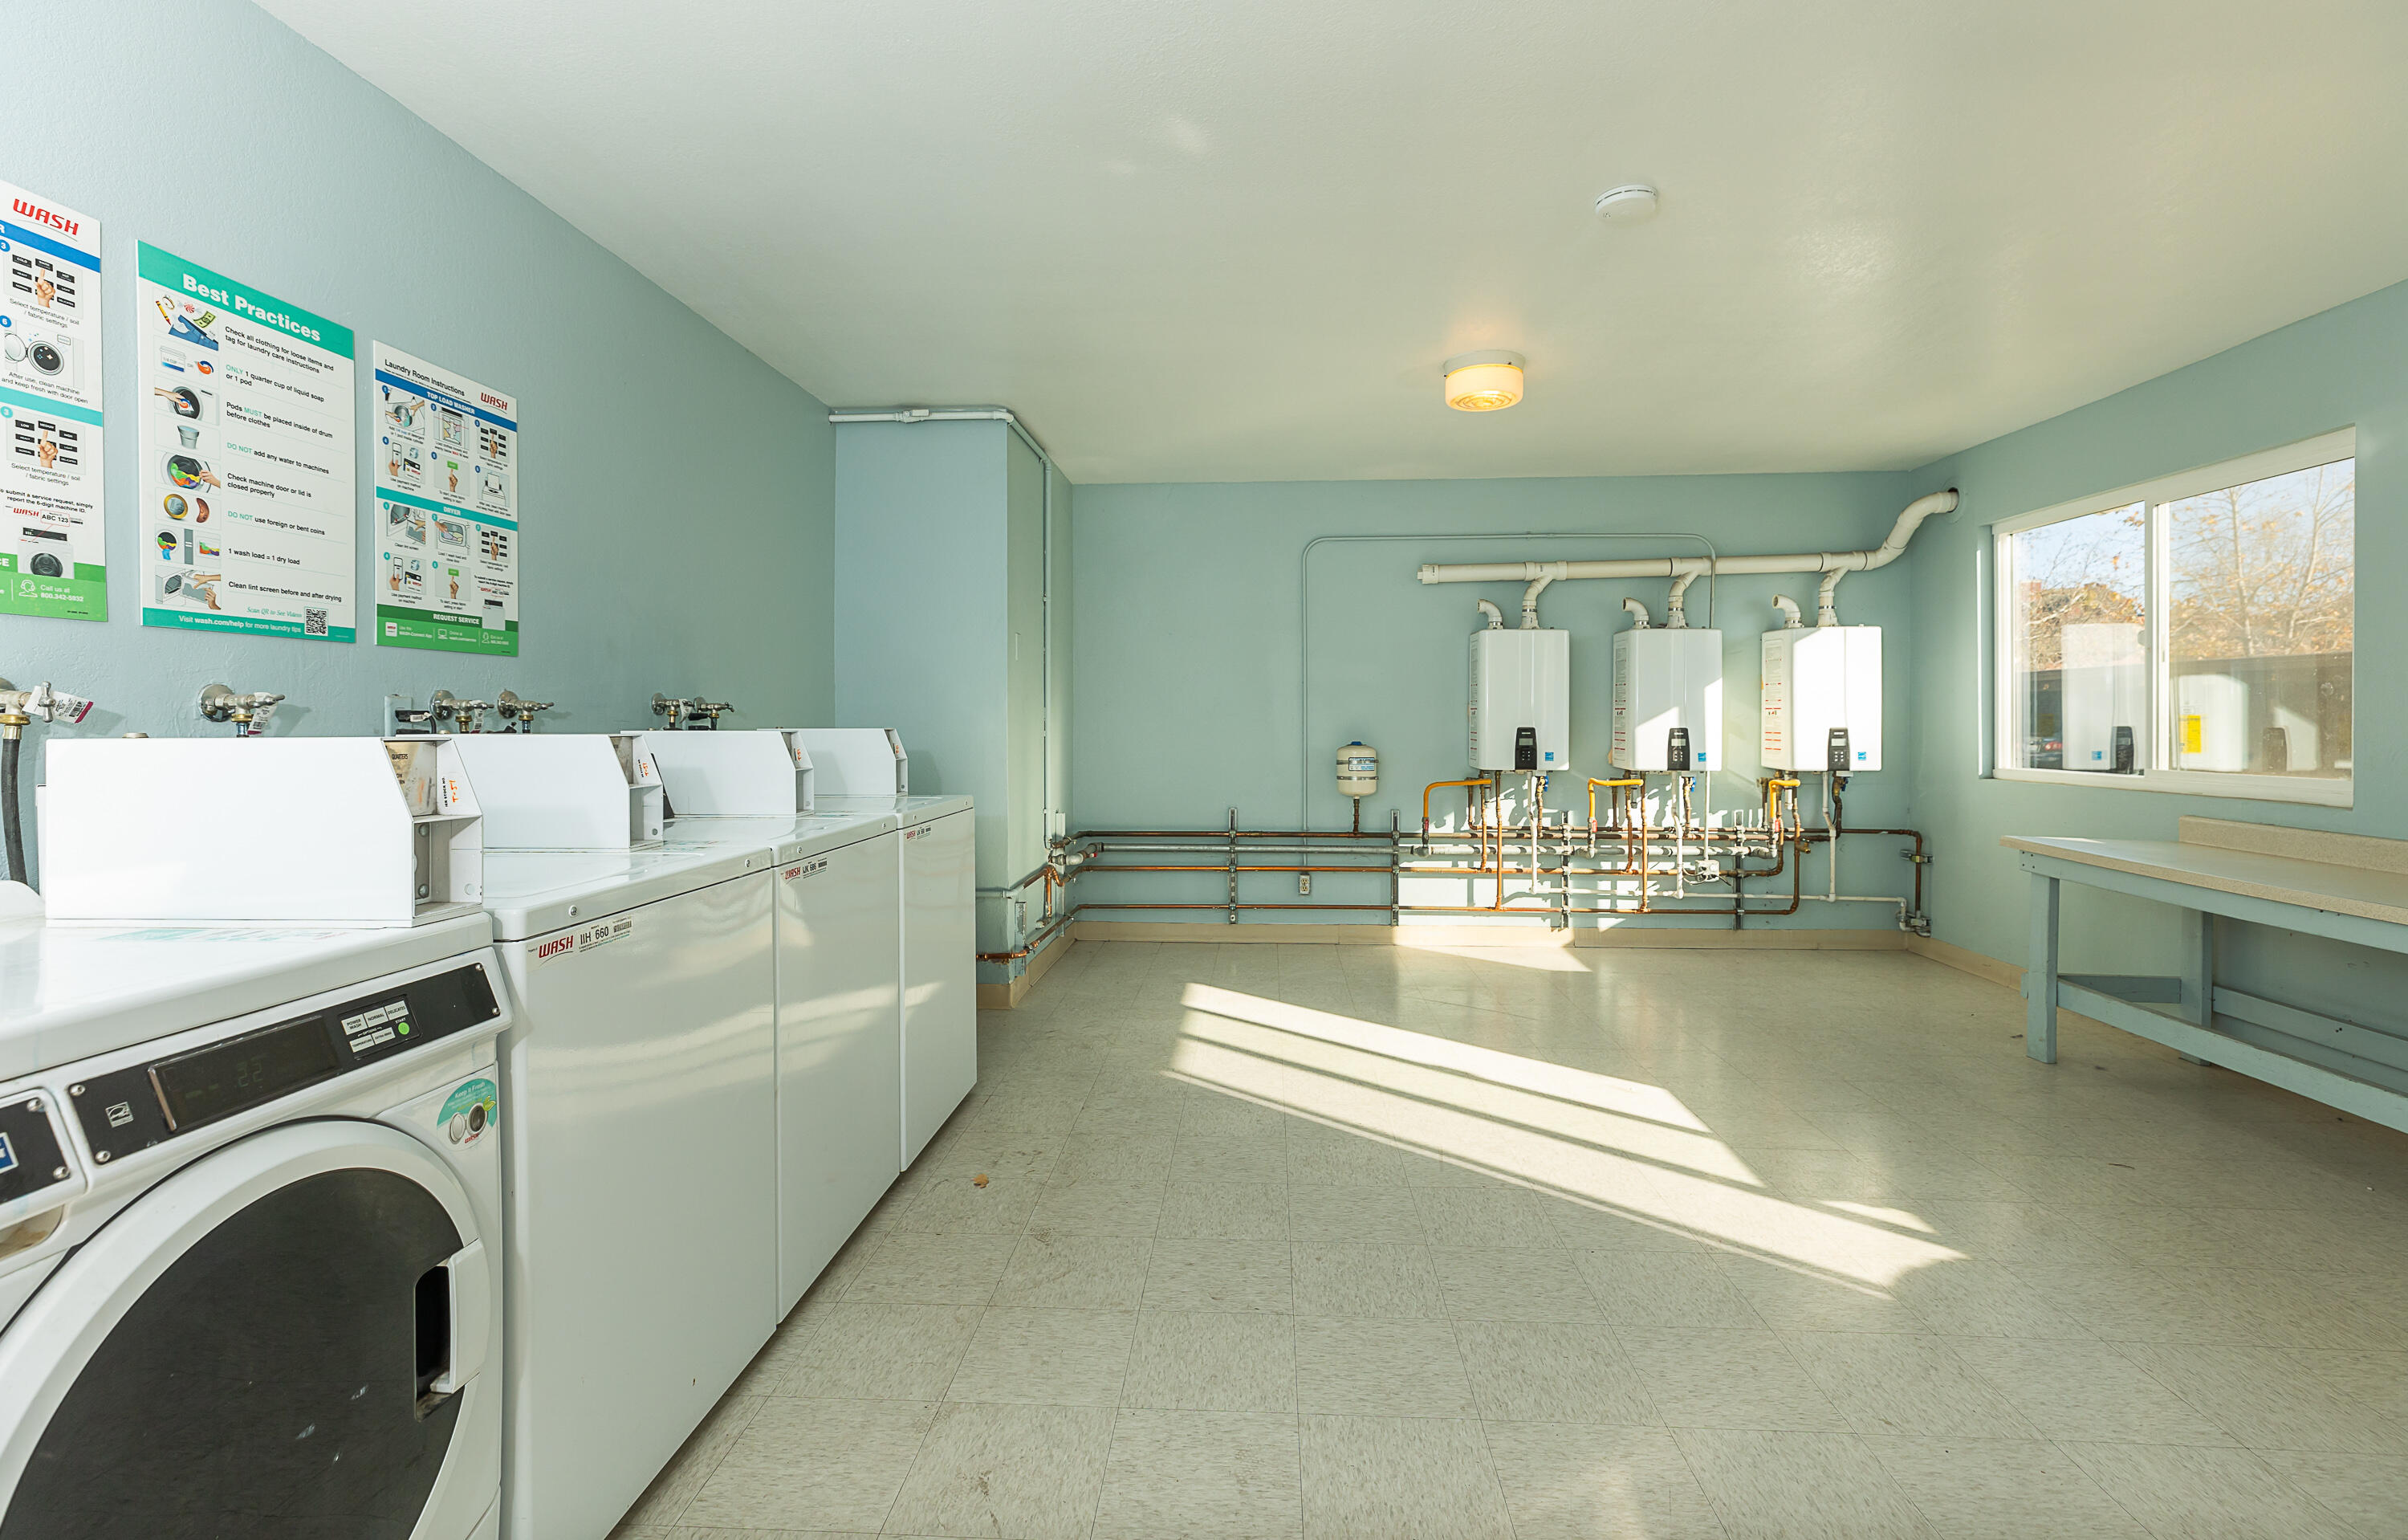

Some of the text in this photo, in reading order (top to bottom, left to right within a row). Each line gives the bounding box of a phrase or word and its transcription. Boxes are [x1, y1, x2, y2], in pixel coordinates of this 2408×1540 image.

[13, 197, 79, 237] WASH
[10, 299, 79, 326] Select temperature soil
[182, 272, 321, 343] Best Practices
[28, 312, 67, 328] fabric settings
[225, 335, 236, 345] tag
[248, 343, 270, 356] laundry
[271, 352, 285, 361] care
[286, 356, 319, 373] instructions
[226, 327, 334, 372] Check all clothing for loose items and
[15, 381, 29, 389] keep
[31, 384, 45, 392] fresh
[39, 380, 55, 389] clean
[56, 385, 80, 395] machine
[226, 364, 244, 376] ONLY
[250, 374, 272, 385] quarter
[294, 388, 309, 397] liquid
[311, 393, 324, 403] soap
[385, 359, 410, 376] Laundry
[413, 370, 430, 383] Room
[431, 377, 465, 397] Instructions
[426, 390, 438, 401] TOP
[439, 395, 453, 406] LOAD
[454, 401, 475, 415] WASHER
[481, 391, 507, 412] WASH
[226, 410, 270, 429] before clothes
[226, 402, 242, 413] Pods
[244, 406, 262, 418] MUST
[273, 418, 291, 426] placed
[293, 422, 311, 433] inside
[319, 429, 333, 439] drum
[226, 442, 238, 451] DO
[238, 446, 253, 454] NOT
[254, 449, 266, 458] add
[279, 456, 295, 466] water
[303, 462, 329, 475] machines
[11, 463, 31, 472] Select
[31, 468, 66, 479] temperature
[30, 473, 45, 482] fabric
[227, 472, 247, 482] Check
[249, 479, 275, 489] machine
[275, 484, 290, 493] door
[227, 482, 275, 498] closed properly
[6, 489, 25, 497] submit
[14, 508, 39, 516] WASH
[55, 504, 77, 512] machine
[227, 510, 238, 519] DO
[254, 516, 266, 524] use
[267, 519, 287, 528] foreign
[296, 524, 309, 532] bent
[311, 528, 325, 536] coins
[234, 548, 250, 557] wash
[251, 552, 265, 560] load
[287, 557, 300, 565] load
[228, 581, 247, 589] Clean
[259, 586, 279, 594] screen
[281, 588, 299, 597] before
[312, 592, 324, 600] after
[325, 595, 341, 603] drying
[179, 615, 193, 624] Visit
[195, 617, 244, 629] wash.com/help
[245, 621, 254, 629] for
[270, 624, 291, 634] laundry
[291, 626, 302, 634] tips
[433, 613, 479, 625] REQUEST SERVICE
[785, 867, 800, 879] WASH
[539, 935, 574, 958] WASH
[595, 927, 608, 939] 660
[347, 1018, 361, 1026] POWER
